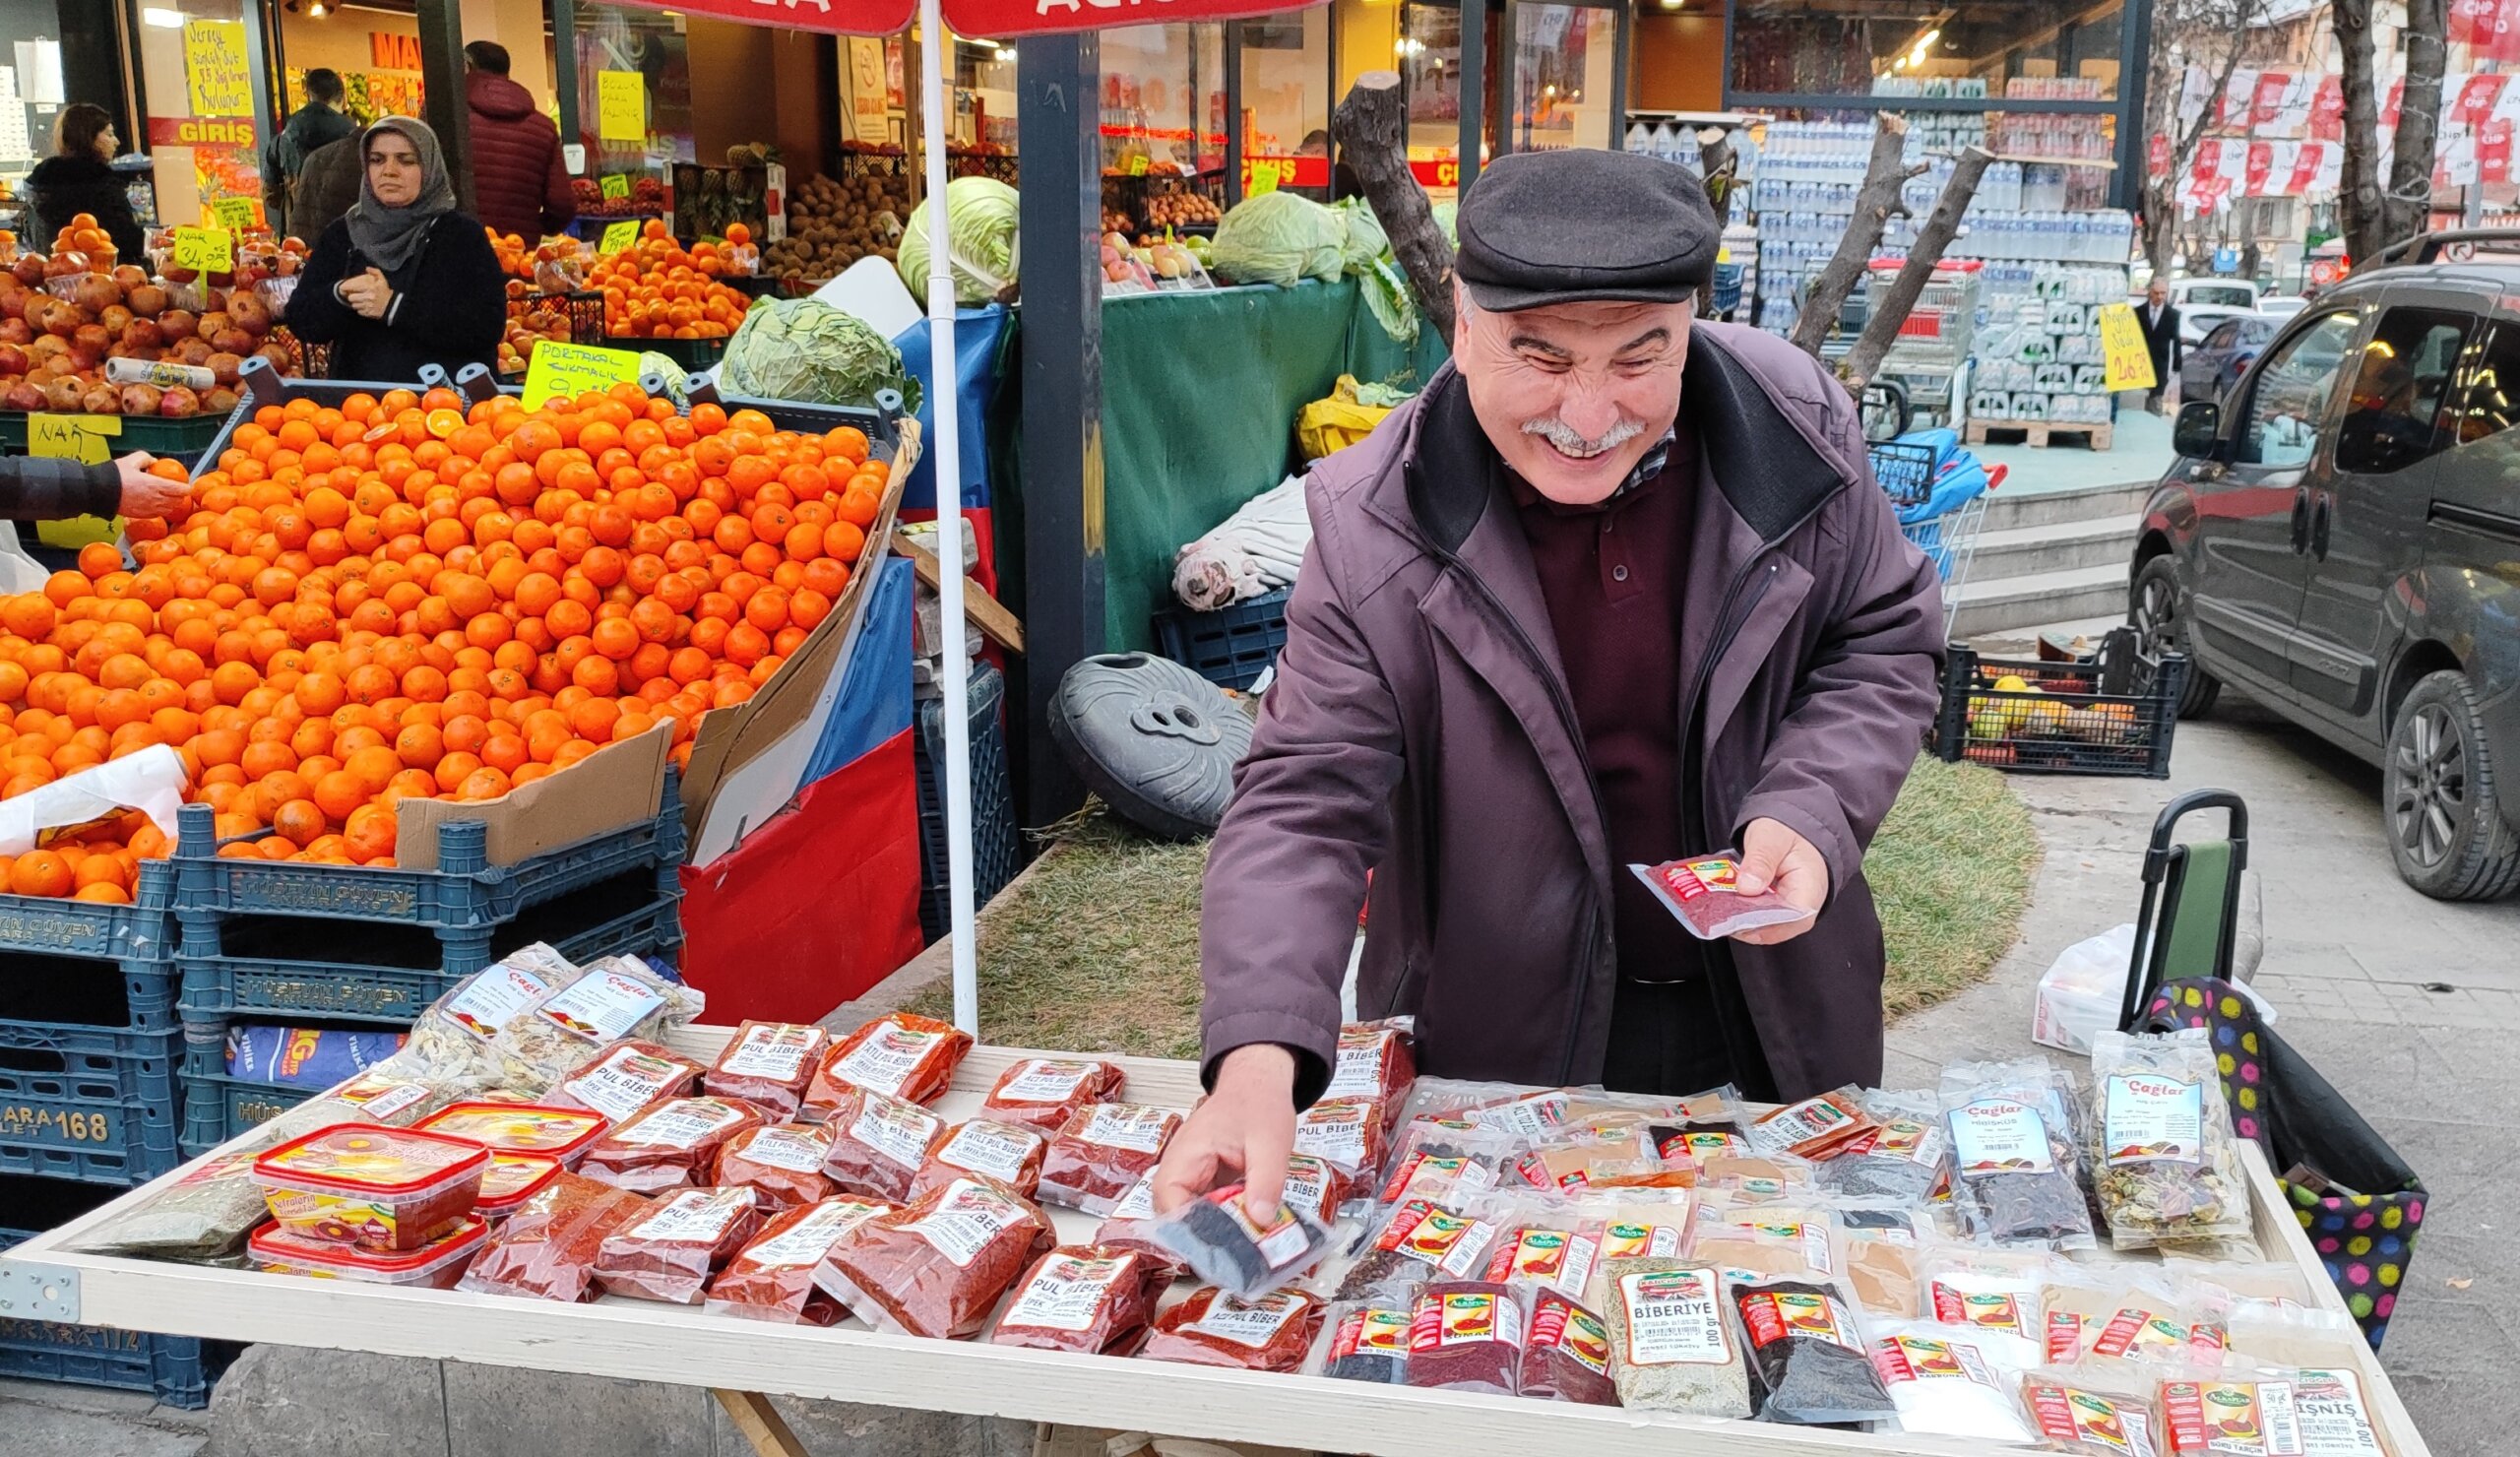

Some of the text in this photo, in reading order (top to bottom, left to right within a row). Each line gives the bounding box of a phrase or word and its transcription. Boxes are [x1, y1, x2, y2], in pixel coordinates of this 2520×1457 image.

[178, 119, 254, 149] GİRİŞ
[30, 919, 96, 937] GÜVEN
[341, 983, 408, 1003] GÜVEN
[508, 972, 543, 996] Çağl
[606, 976, 654, 999] Çağlar
[741, 1044, 765, 1054] PUL
[1347, 1047, 1383, 1062] BİBER
[596, 1067, 661, 1097] PUL BİBER
[2128, 1080, 2187, 1097] Çağlar
[1968, 1105, 2024, 1118] Çağlar
[56, 1110, 108, 1142] 168
[1096, 1115, 1119, 1128] PUL
[1297, 1122, 1366, 1136] PUL BİBER
[1292, 1182, 1320, 1198] BİBER
[1031, 1279, 1111, 1296] PUL BİBER
[1249, 1311, 1282, 1325] BİBER
[1634, 1300, 1713, 1319] BİBERİYE
[1706, 1329, 1721, 1347] 100
[2295, 1401, 2357, 1419] İŞNİŞ
